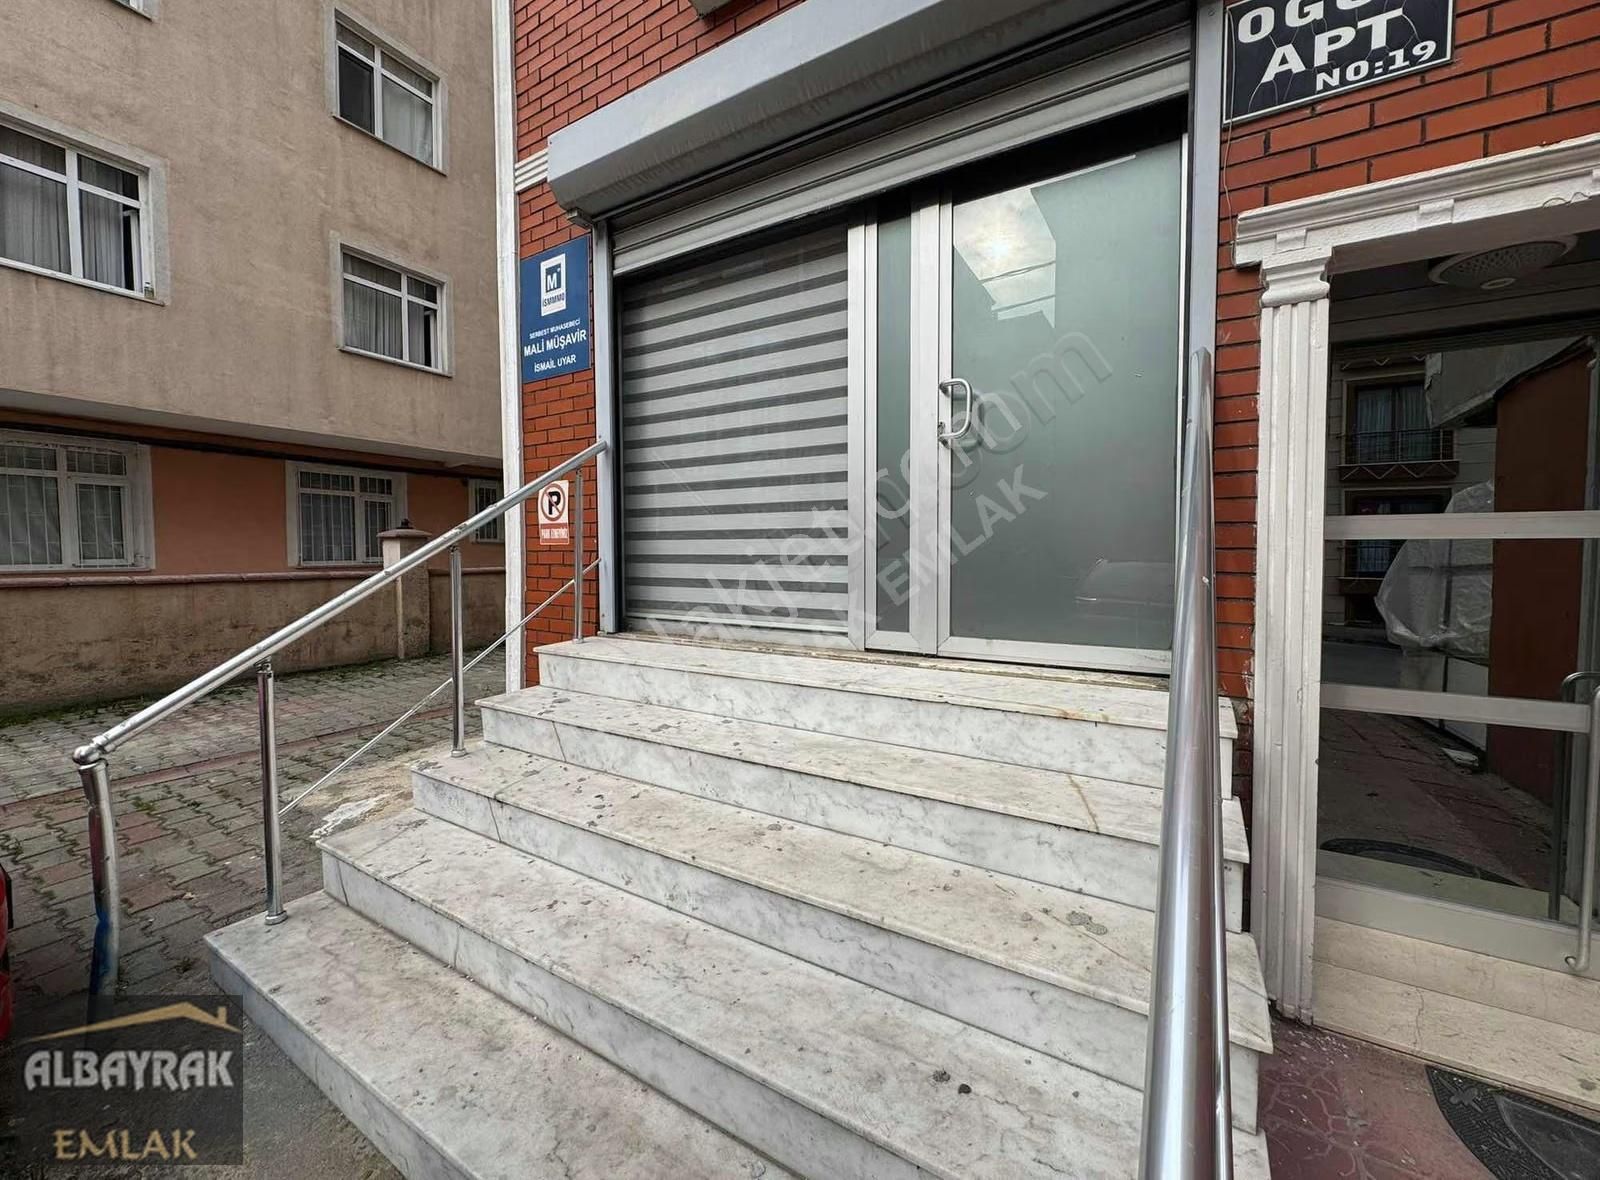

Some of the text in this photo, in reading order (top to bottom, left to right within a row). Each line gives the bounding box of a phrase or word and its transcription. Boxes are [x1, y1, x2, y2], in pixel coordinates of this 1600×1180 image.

[1261, 8, 1403, 84] APT
[1316, 40, 1437, 92] NO:19
[524, 328, 586, 357] MALİ MÜŞAVİR
[557, 354, 576, 367] UYAR
